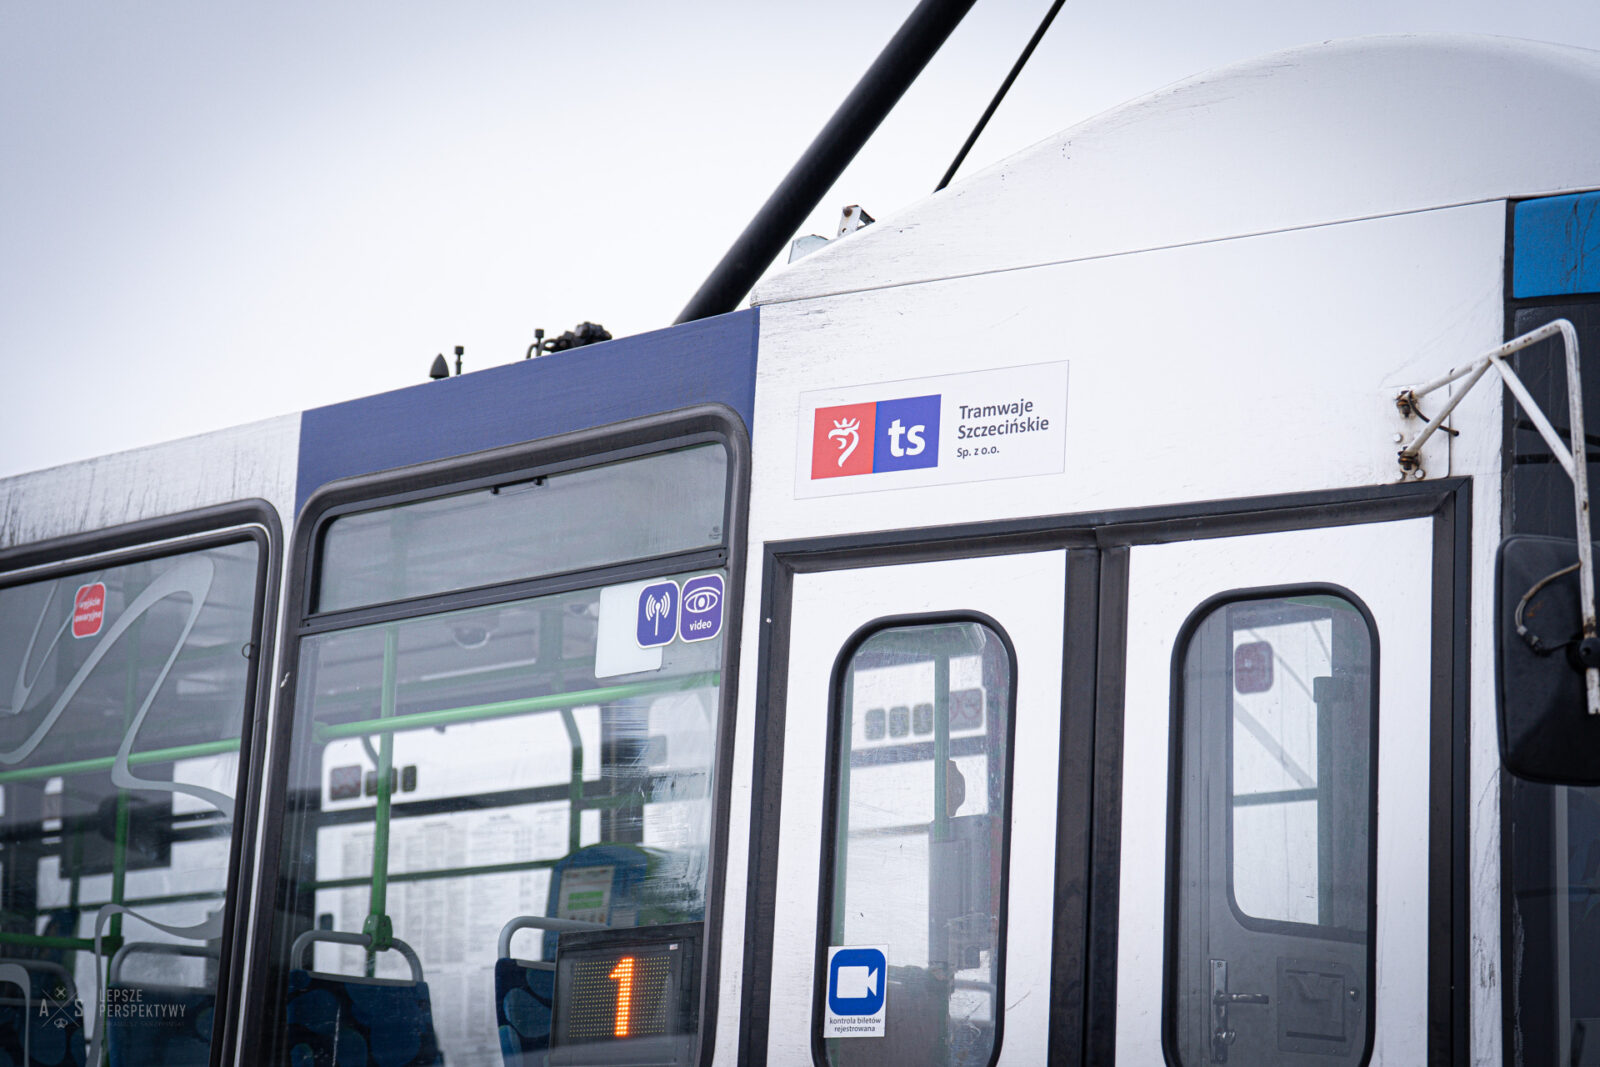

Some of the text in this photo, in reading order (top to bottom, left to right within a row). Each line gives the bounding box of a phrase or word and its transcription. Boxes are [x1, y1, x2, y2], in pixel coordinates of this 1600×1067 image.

[959, 398, 1034, 420] Tramwaje
[957, 416, 1050, 440] Szczecińskie
[888, 418, 926, 458] ts
[957, 445, 1000, 459] Sp. z o.o.
[689, 619, 713, 632] video
[608, 956, 635, 1038] 1
[834, 1025, 876, 1033] rejestrowana
[857, 1016, 881, 1024] biletów
